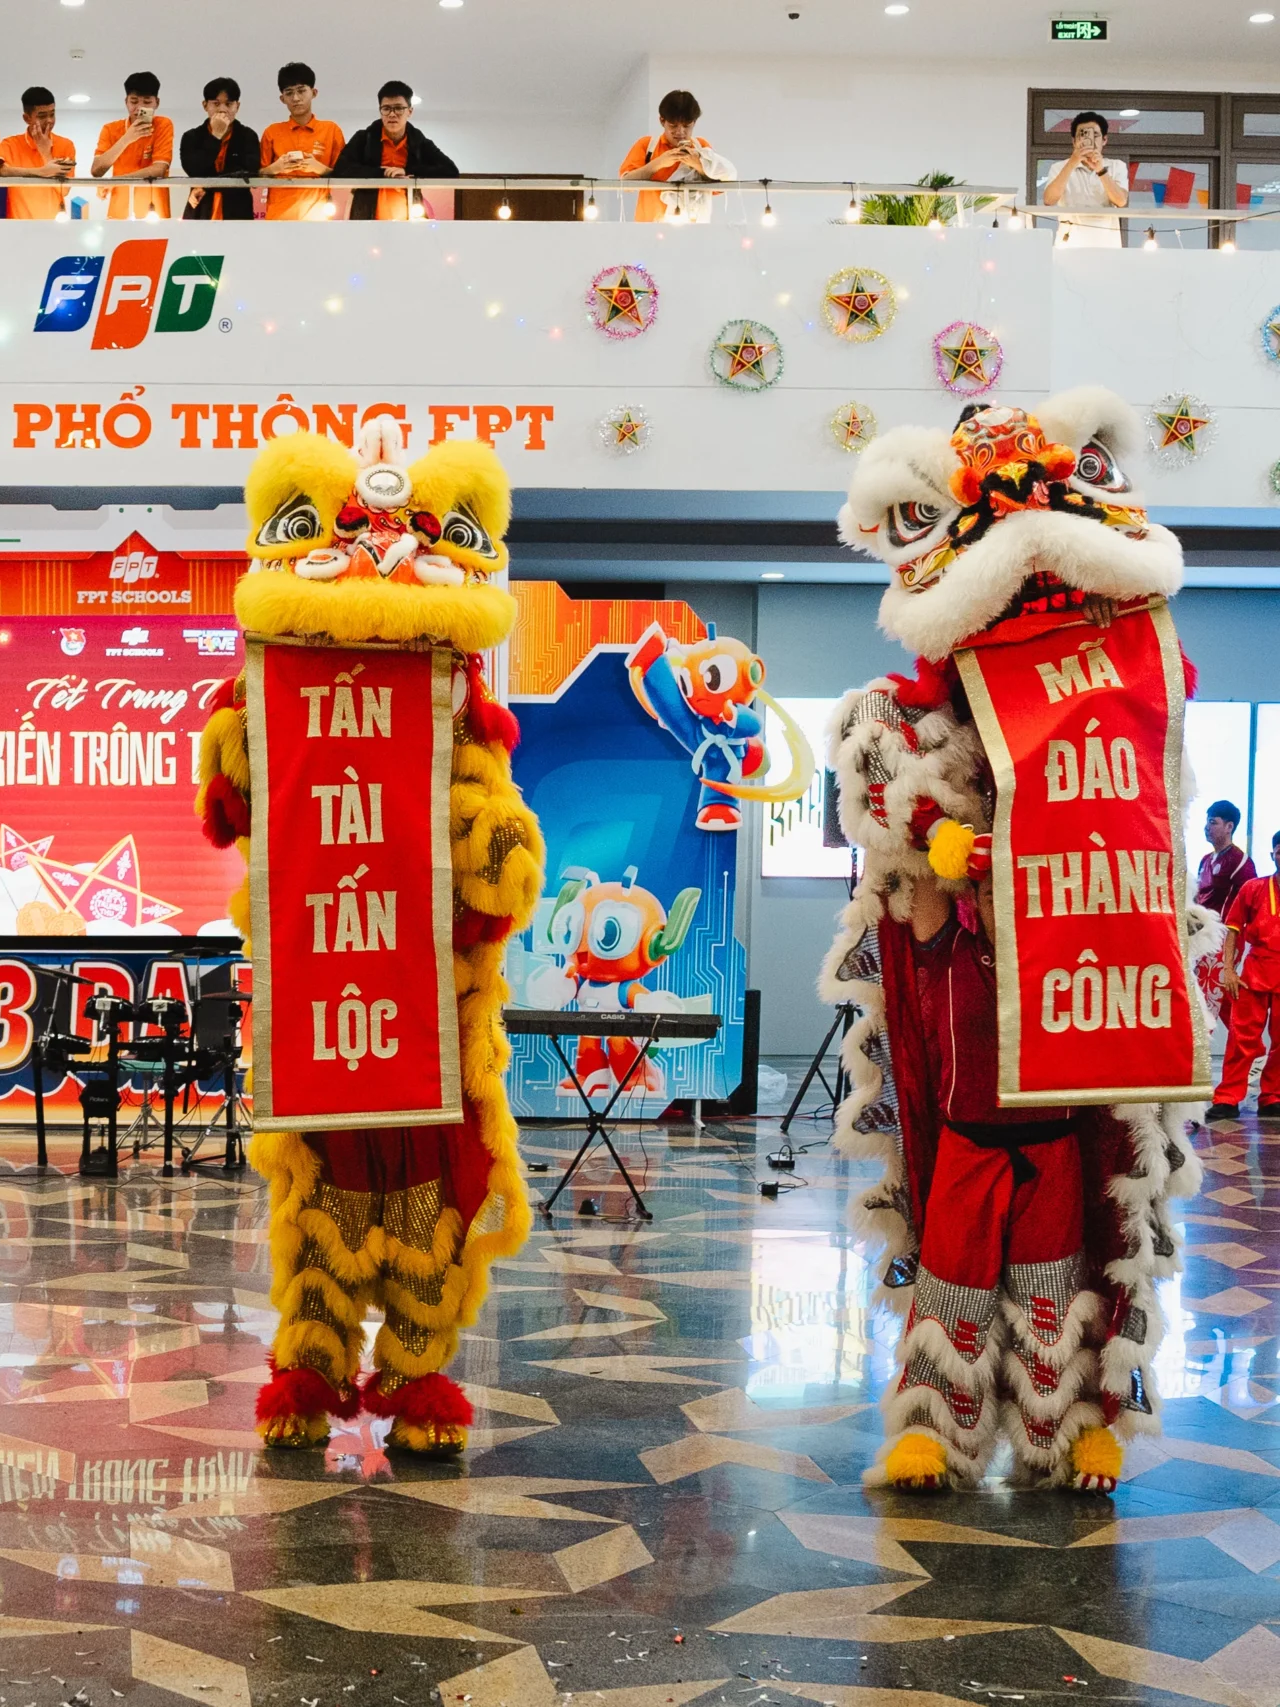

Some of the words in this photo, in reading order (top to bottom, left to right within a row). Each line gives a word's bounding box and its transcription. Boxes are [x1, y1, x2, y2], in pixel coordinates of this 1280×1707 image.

[13, 385, 152, 449] PHỔ
[171, 393, 413, 450] THÔNG
[428, 405, 554, 450] FPT
[76, 590, 108, 604] FPT
[112, 590, 193, 604] SCHOOLS
[26, 674, 89, 711] Tết
[95, 678, 188, 725] Trung
[300, 663, 393, 739] TẤN
[1034, 637, 1124, 704] MÃ
[70, 721, 177, 787] TRÔNG
[1044, 717, 1140, 803] ĐÁO
[311, 765, 385, 845] TÀI
[305, 863, 398, 953] TẤN
[1016, 830, 1174, 919] THÀNH
[311, 982, 399, 1071] LỘC
[1040, 948, 1173, 1034] CÔNG
